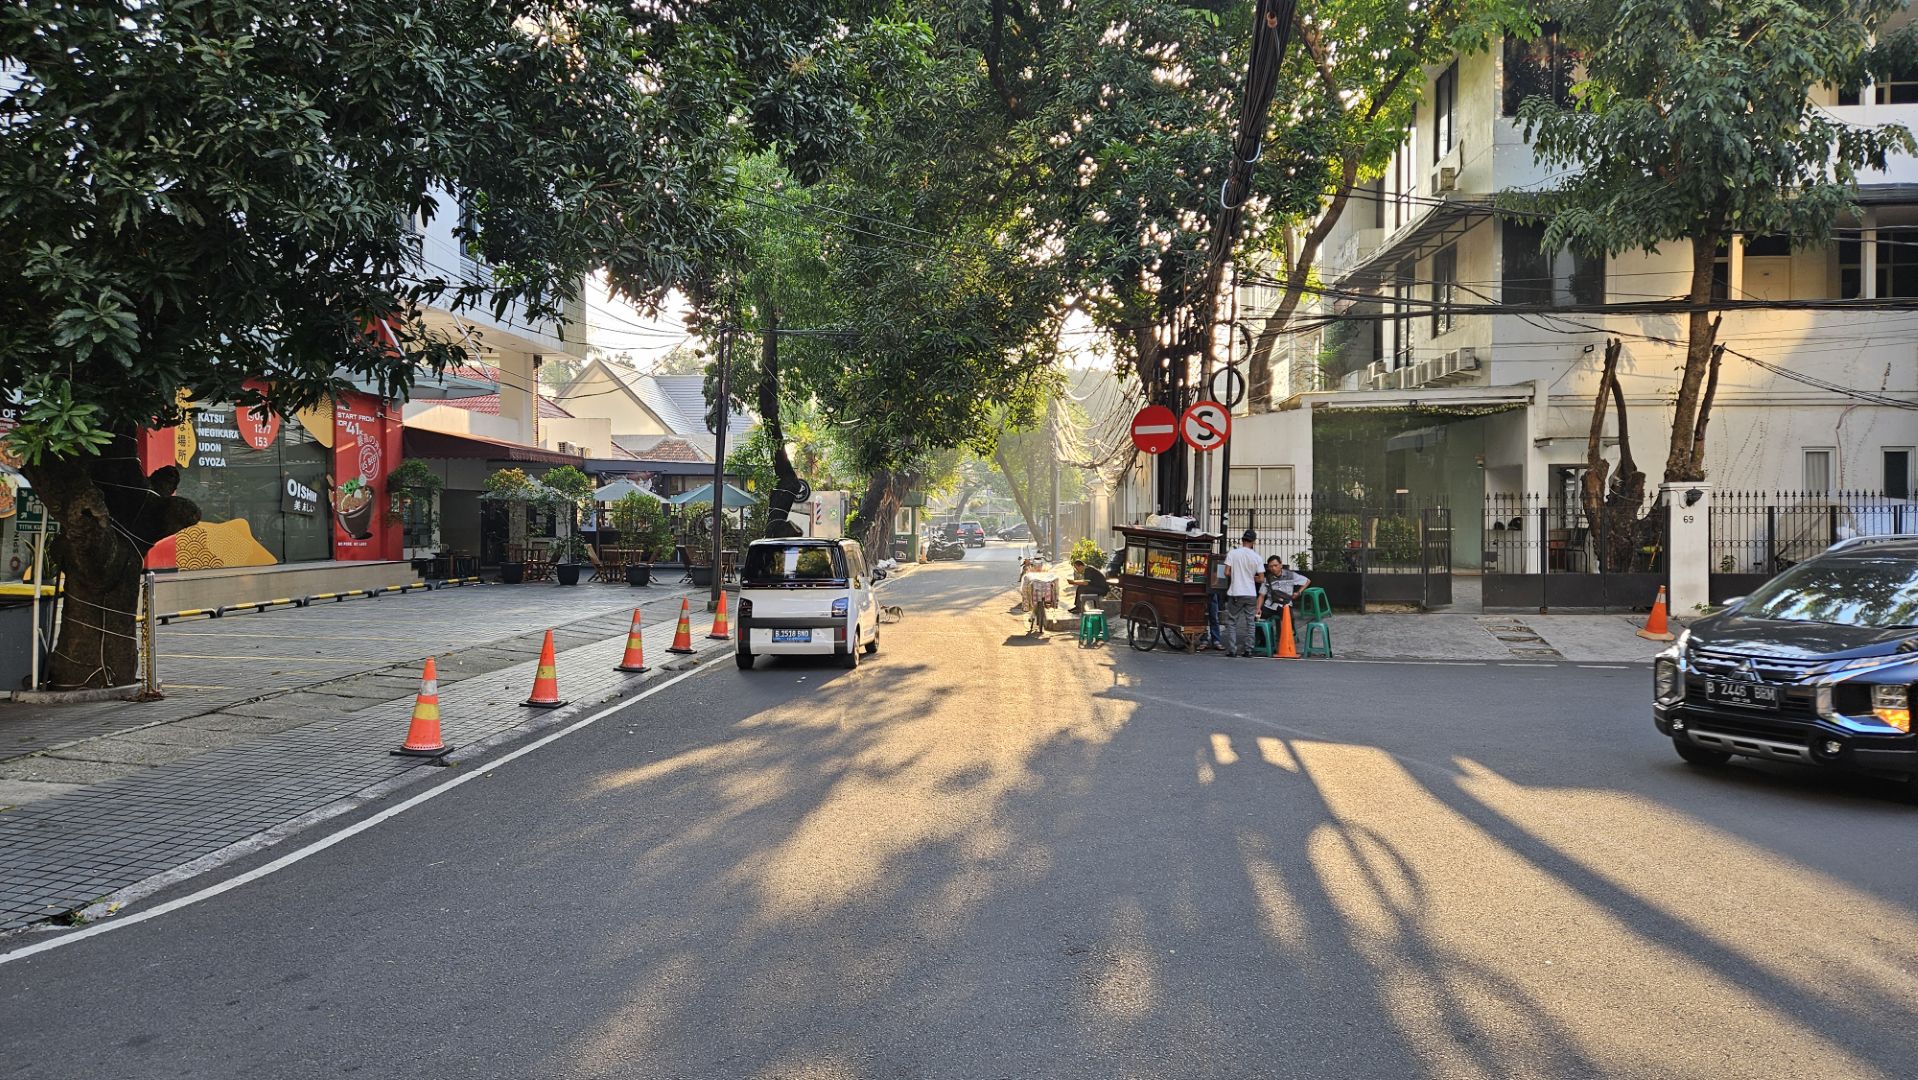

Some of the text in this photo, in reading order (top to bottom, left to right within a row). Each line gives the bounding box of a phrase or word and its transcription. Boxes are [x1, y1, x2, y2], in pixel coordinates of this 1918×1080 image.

[2, 408, 17, 419] OF
[198, 412, 225, 424] KATSU
[337, 412, 375, 423] START FROM
[1197, 410, 1215, 441] S
[198, 428, 240, 439] NEGIKARA
[198, 442, 223, 452] UDON
[254, 436, 269, 447] 153
[198, 457, 228, 468] GYOZA
[287, 478, 318, 503] OISHII
[1683, 515, 1694, 524] 69
[18, 524, 33, 532] TITIK
[1706, 681, 1716, 694] B
